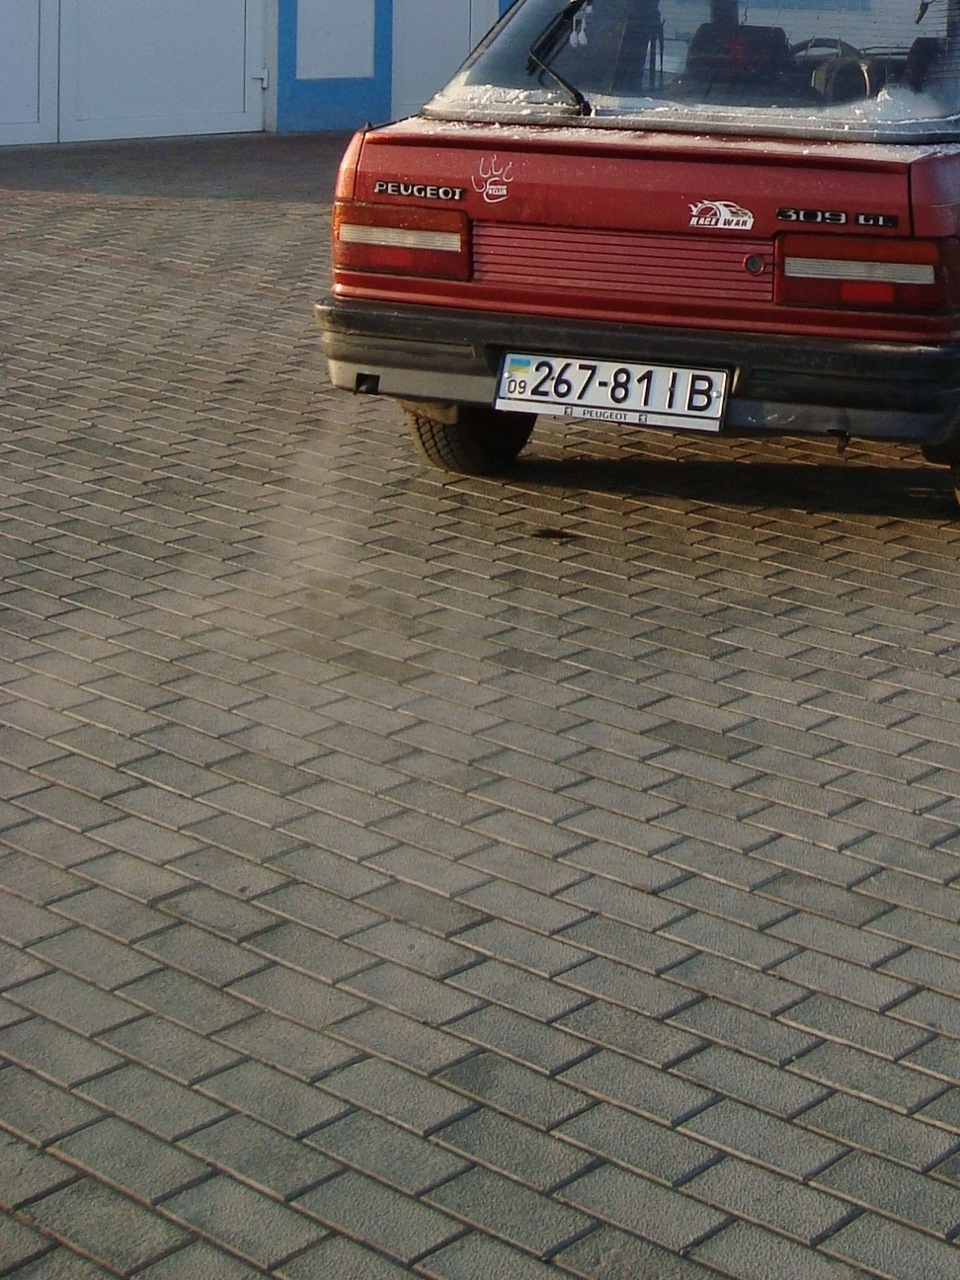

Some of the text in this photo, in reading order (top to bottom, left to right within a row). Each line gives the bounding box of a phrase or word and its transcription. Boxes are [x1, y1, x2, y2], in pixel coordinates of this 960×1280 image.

[374, 181, 464, 201] PEUGEOT
[690, 216, 718, 227] RACE
[776, 208, 847, 224] 309
[507, 378, 527, 395] 09
[582, 408, 628, 421] PEUGEOT
